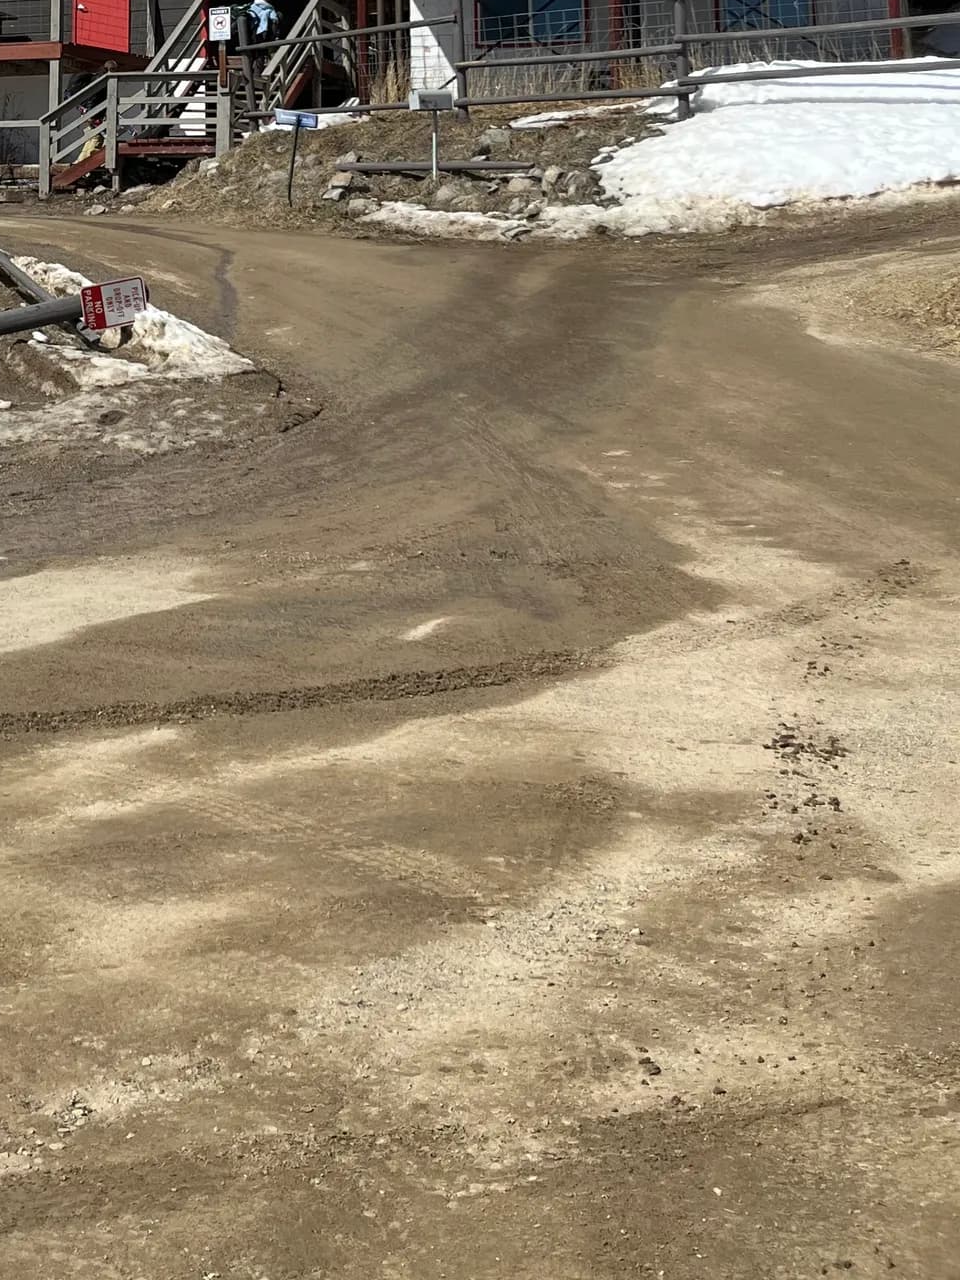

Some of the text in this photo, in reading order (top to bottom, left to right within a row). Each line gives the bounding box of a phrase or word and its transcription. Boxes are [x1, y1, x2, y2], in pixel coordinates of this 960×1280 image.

[94, 302, 103, 314] NO
[106, 297, 114, 312] ONLY
[123, 295, 132, 308] AND
[83, 290, 96, 328] PARKING
